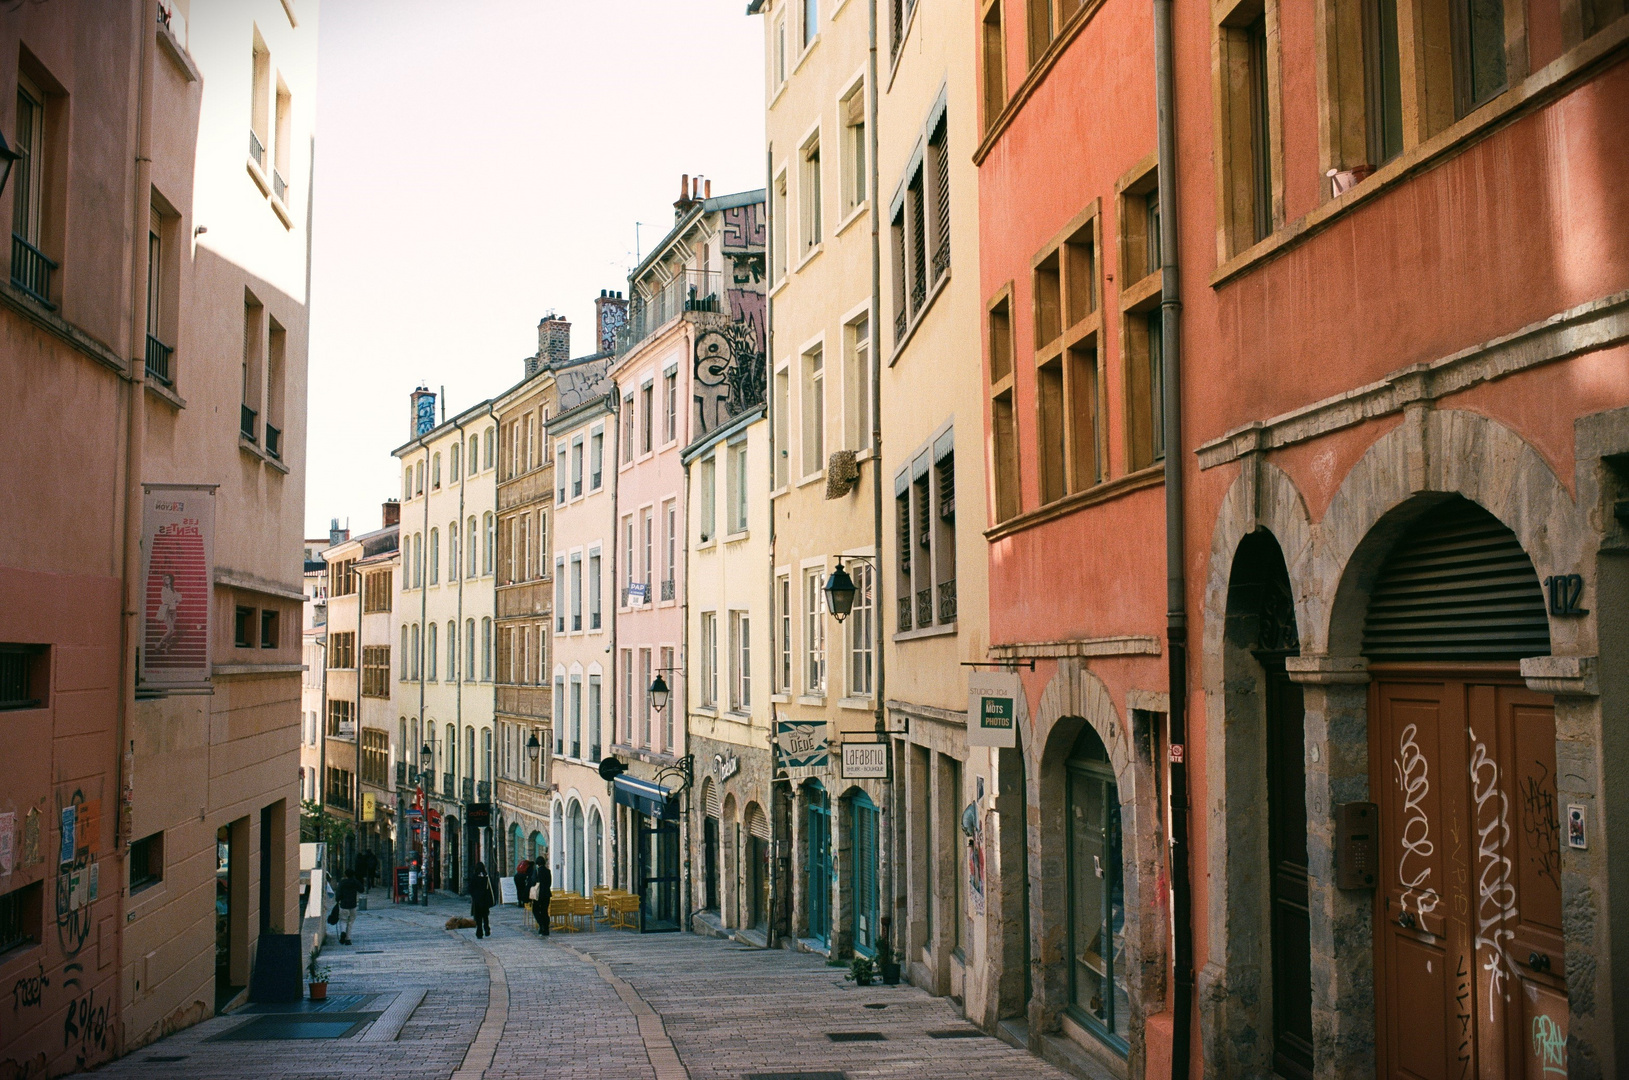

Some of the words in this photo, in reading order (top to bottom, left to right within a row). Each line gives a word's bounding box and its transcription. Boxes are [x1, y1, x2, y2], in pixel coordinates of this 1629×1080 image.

[1543, 574, 1590, 616] 102
[969, 687, 994, 696] STUDIO
[985, 704, 1004, 714] MOTS
[985, 717, 1010, 727] PHOTOS
[790, 734, 815, 754] DÉDÉ
